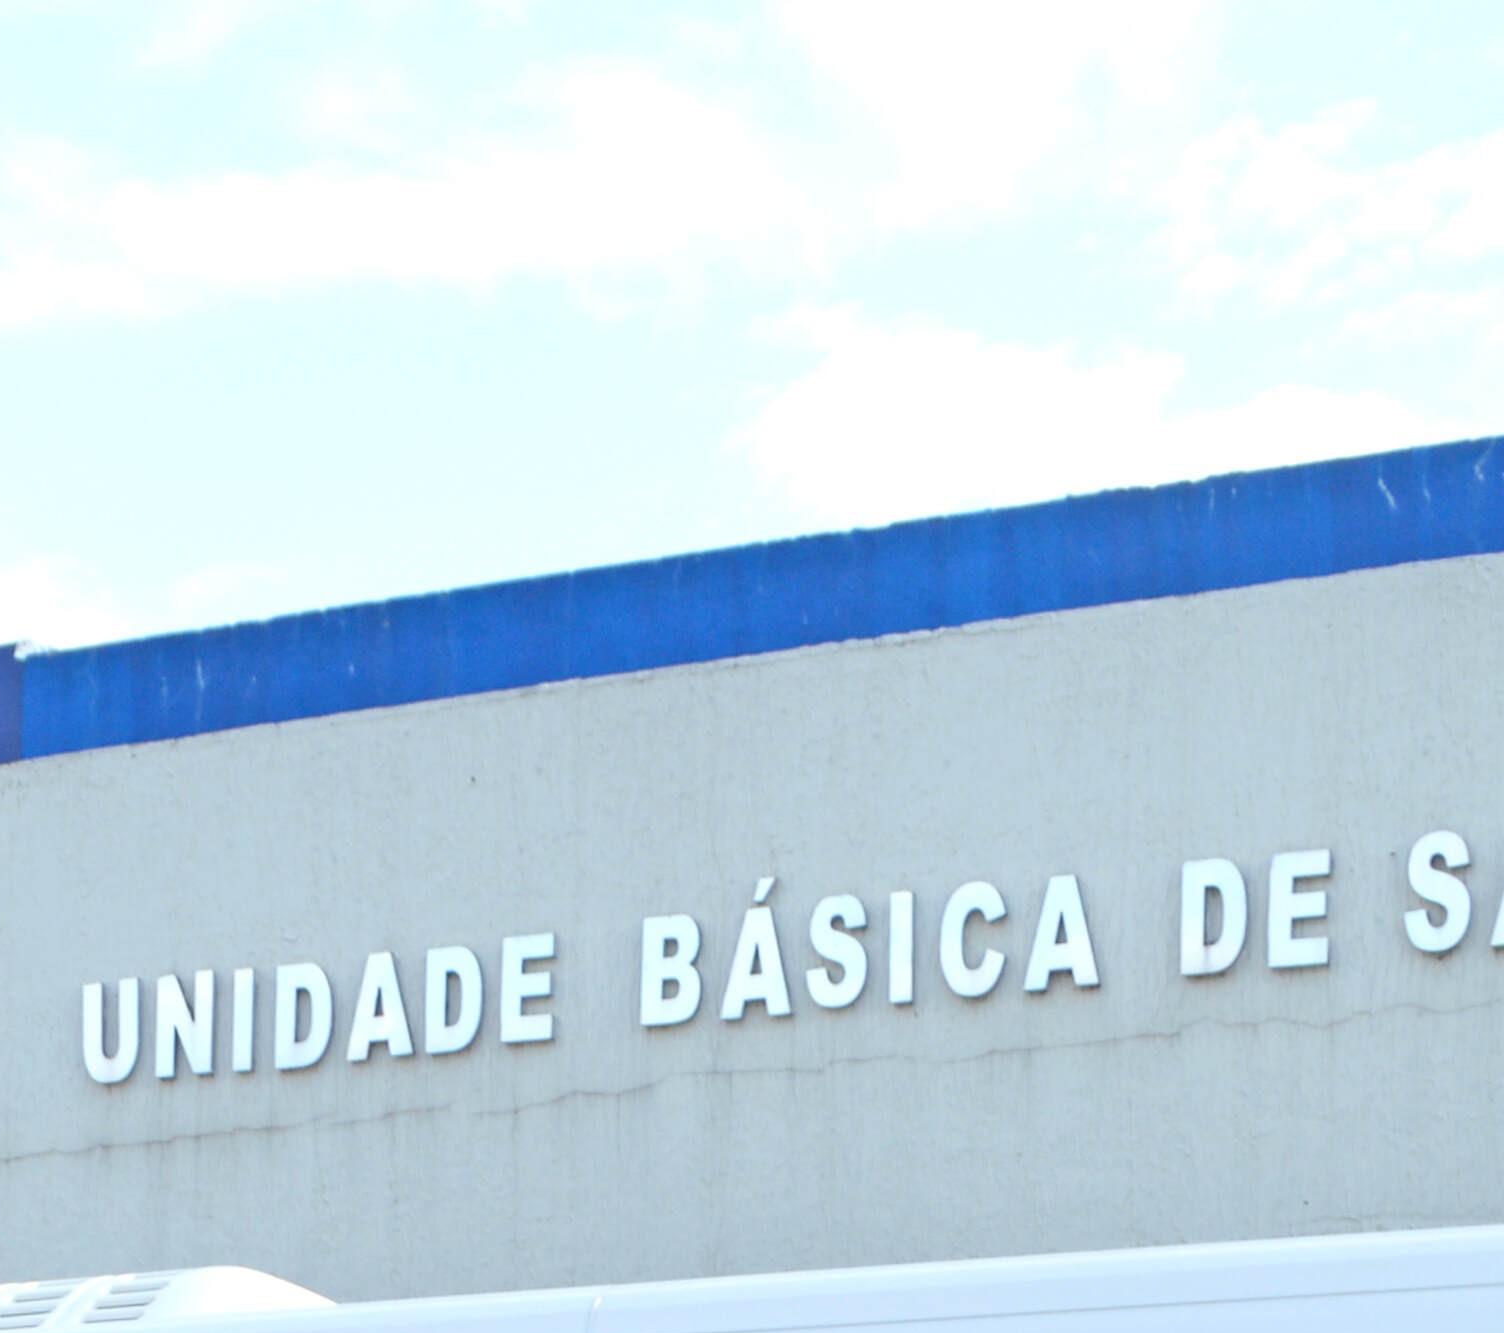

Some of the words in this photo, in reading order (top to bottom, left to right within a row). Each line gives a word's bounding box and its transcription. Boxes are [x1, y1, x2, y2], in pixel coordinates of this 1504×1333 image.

[82, 931, 557, 1085] UNIDADE
[639, 873, 1100, 1028] BÁSICA
[1180, 848, 1332, 977] DE
